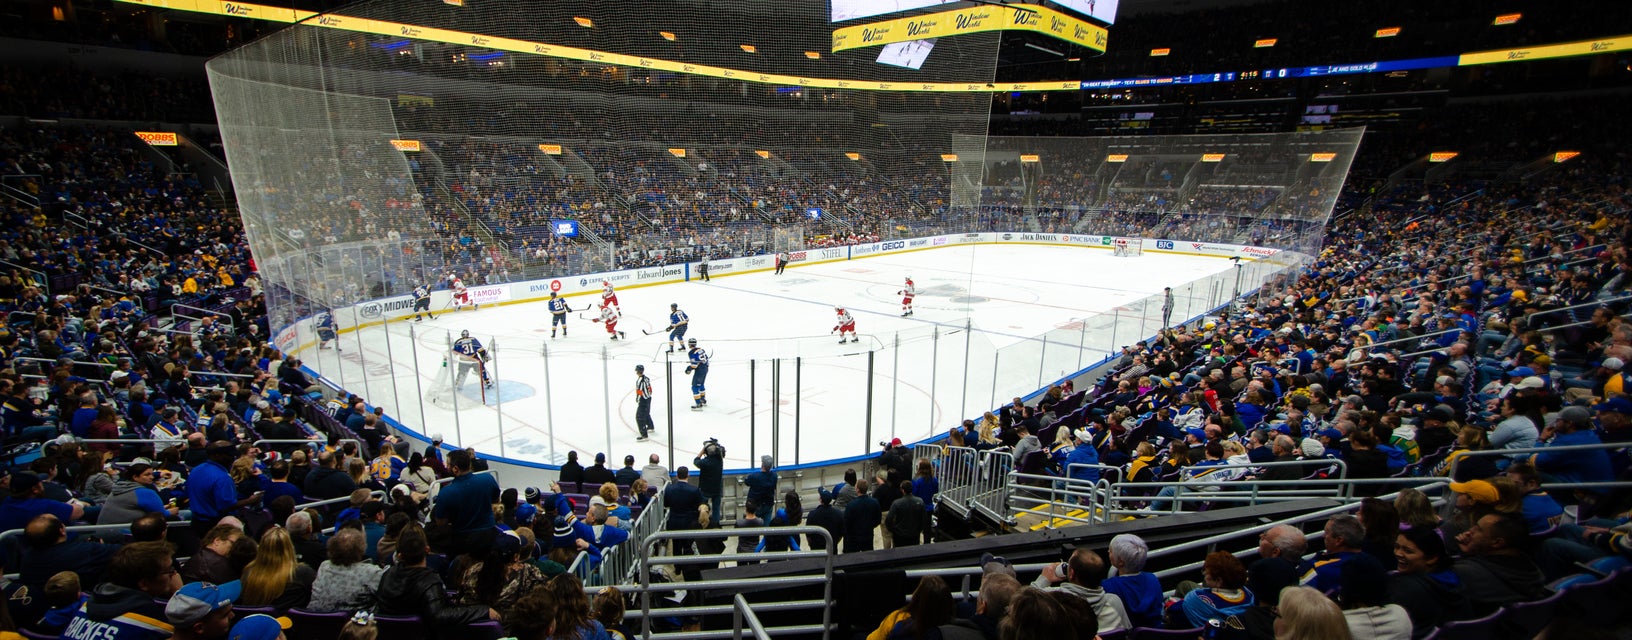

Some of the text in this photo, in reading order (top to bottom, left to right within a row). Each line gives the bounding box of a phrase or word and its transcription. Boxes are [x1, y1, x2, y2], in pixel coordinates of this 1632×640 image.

[956, 12, 990, 29] Window
[907, 21, 937, 36] Window
[862, 28, 889, 43] Window
[1213, 73, 1220, 81] 2
[1278, 69, 1286, 77] 0
[882, 241, 904, 251] GEICO
[1158, 241, 1173, 249] BJC
[821, 249, 842, 260] STIFEL
[1241, 246, 1277, 257] Schnucks
[752, 258, 765, 266] Bayer
[473, 288, 502, 298] FAMOUS
[530, 283, 549, 293] BMO
[383, 298, 414, 313] MIDWE
[554, 301, 564, 311] 21
[462, 343, 475, 355] 31
[64, 616, 119, 640] BACKES
